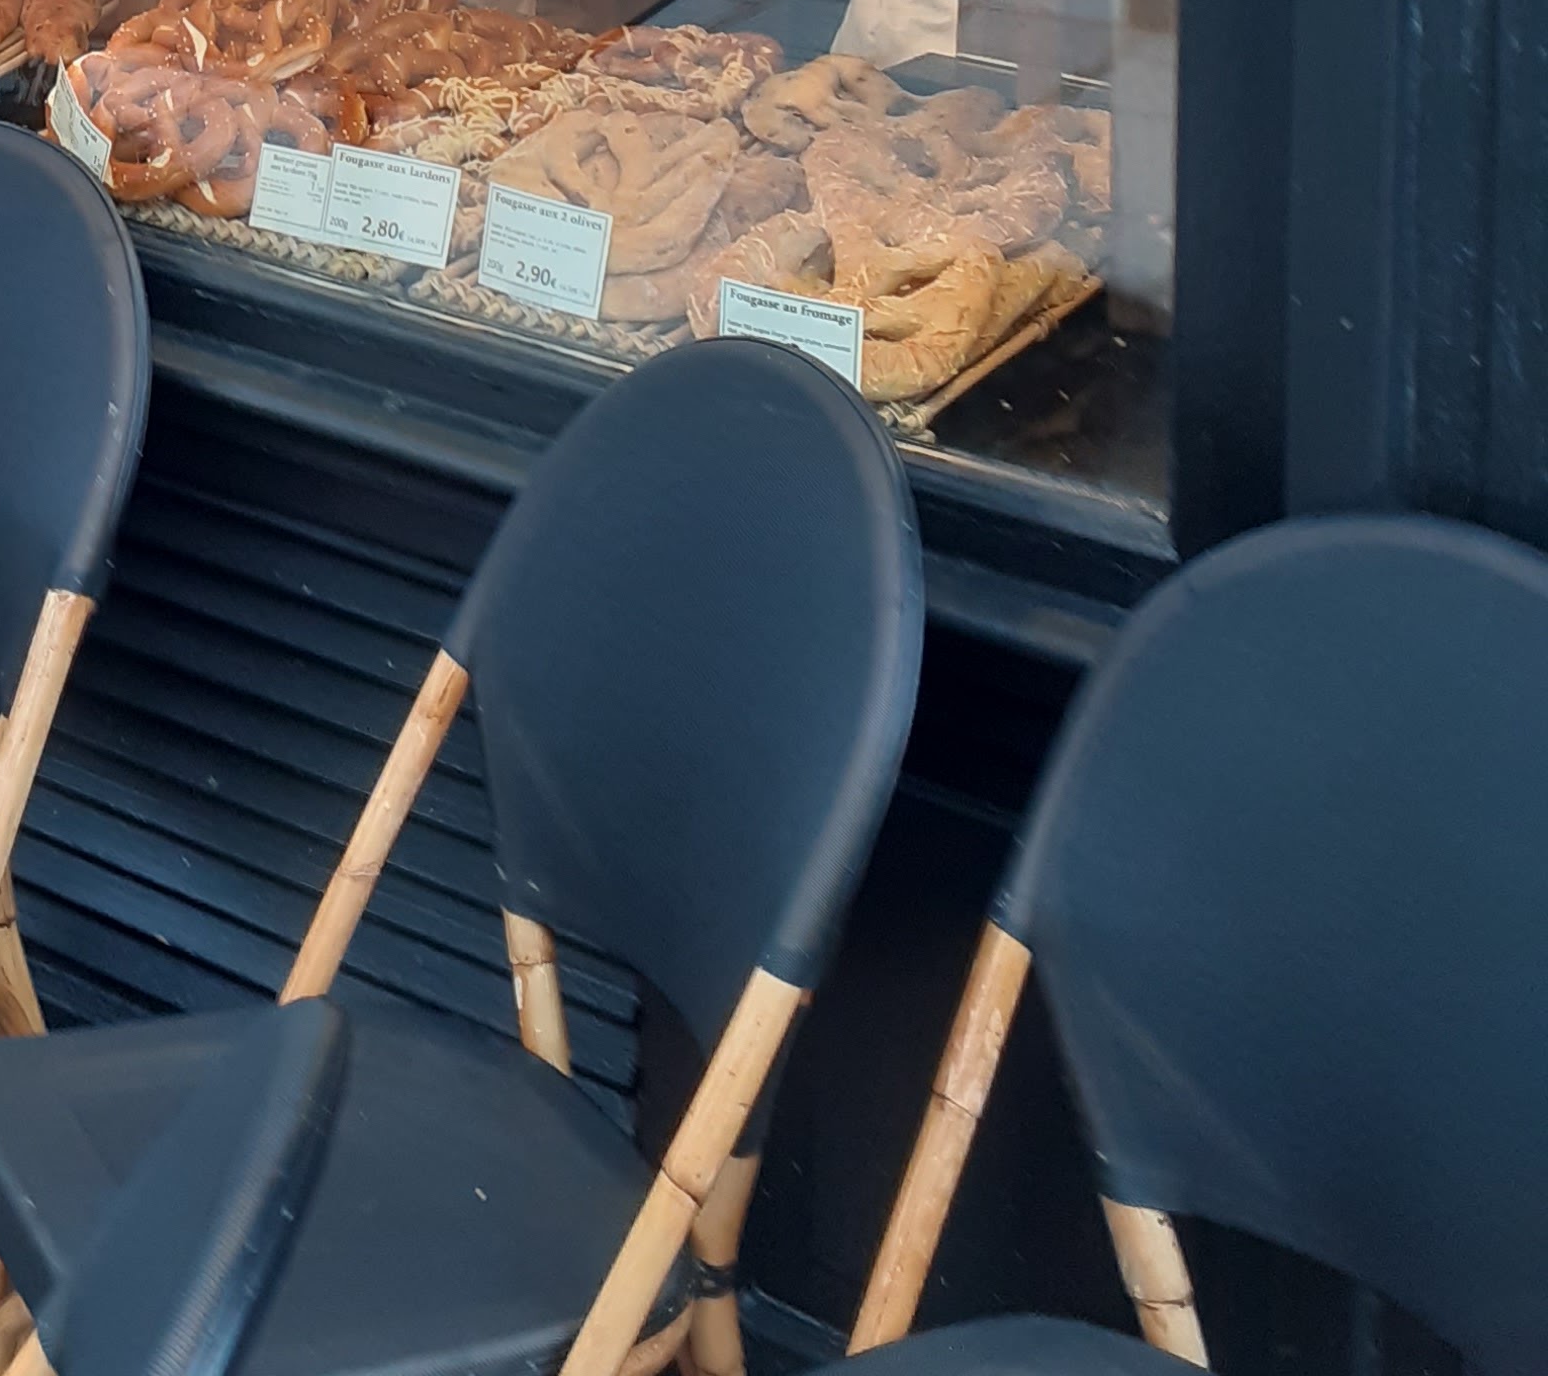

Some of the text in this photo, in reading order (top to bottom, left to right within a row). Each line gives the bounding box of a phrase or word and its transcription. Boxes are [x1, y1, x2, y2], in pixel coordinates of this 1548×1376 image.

[339, 151, 452, 185] Fougasse aux lardons
[360, 215, 406, 241] 2,80€
[494, 191, 603, 231] Fougasse aux 2 olives
[514, 259, 558, 290] 2,90€
[728, 287, 853, 327] Fougasse au fromage
